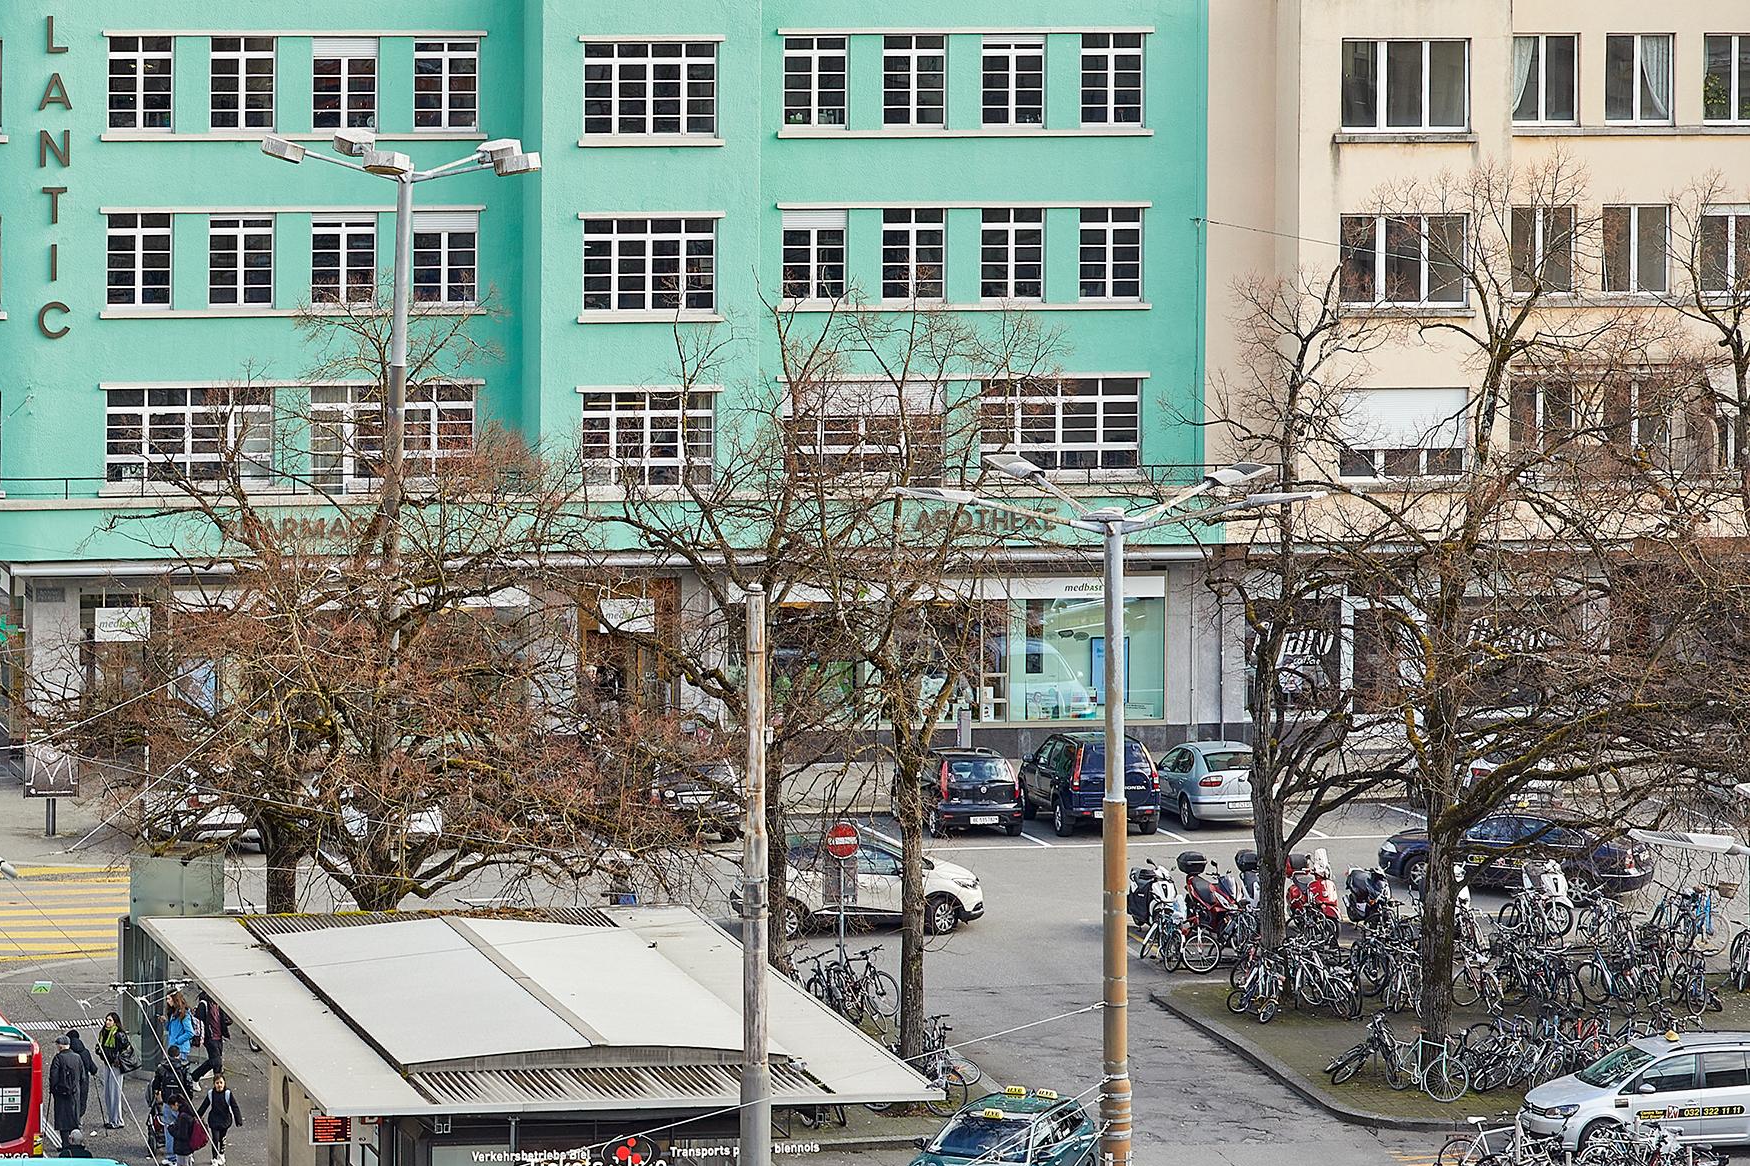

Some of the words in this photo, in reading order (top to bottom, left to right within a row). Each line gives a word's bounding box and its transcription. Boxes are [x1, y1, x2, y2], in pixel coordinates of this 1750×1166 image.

[38, 15, 72, 339] LANTIC
[1684, 1108, 1700, 1117] 032
[1703, 1107, 1719, 1115] 322
[1733, 1106, 1741, 1114] 11
[670, 1145, 730, 1159] Transports
[774, 1142, 820, 1154] biennois
